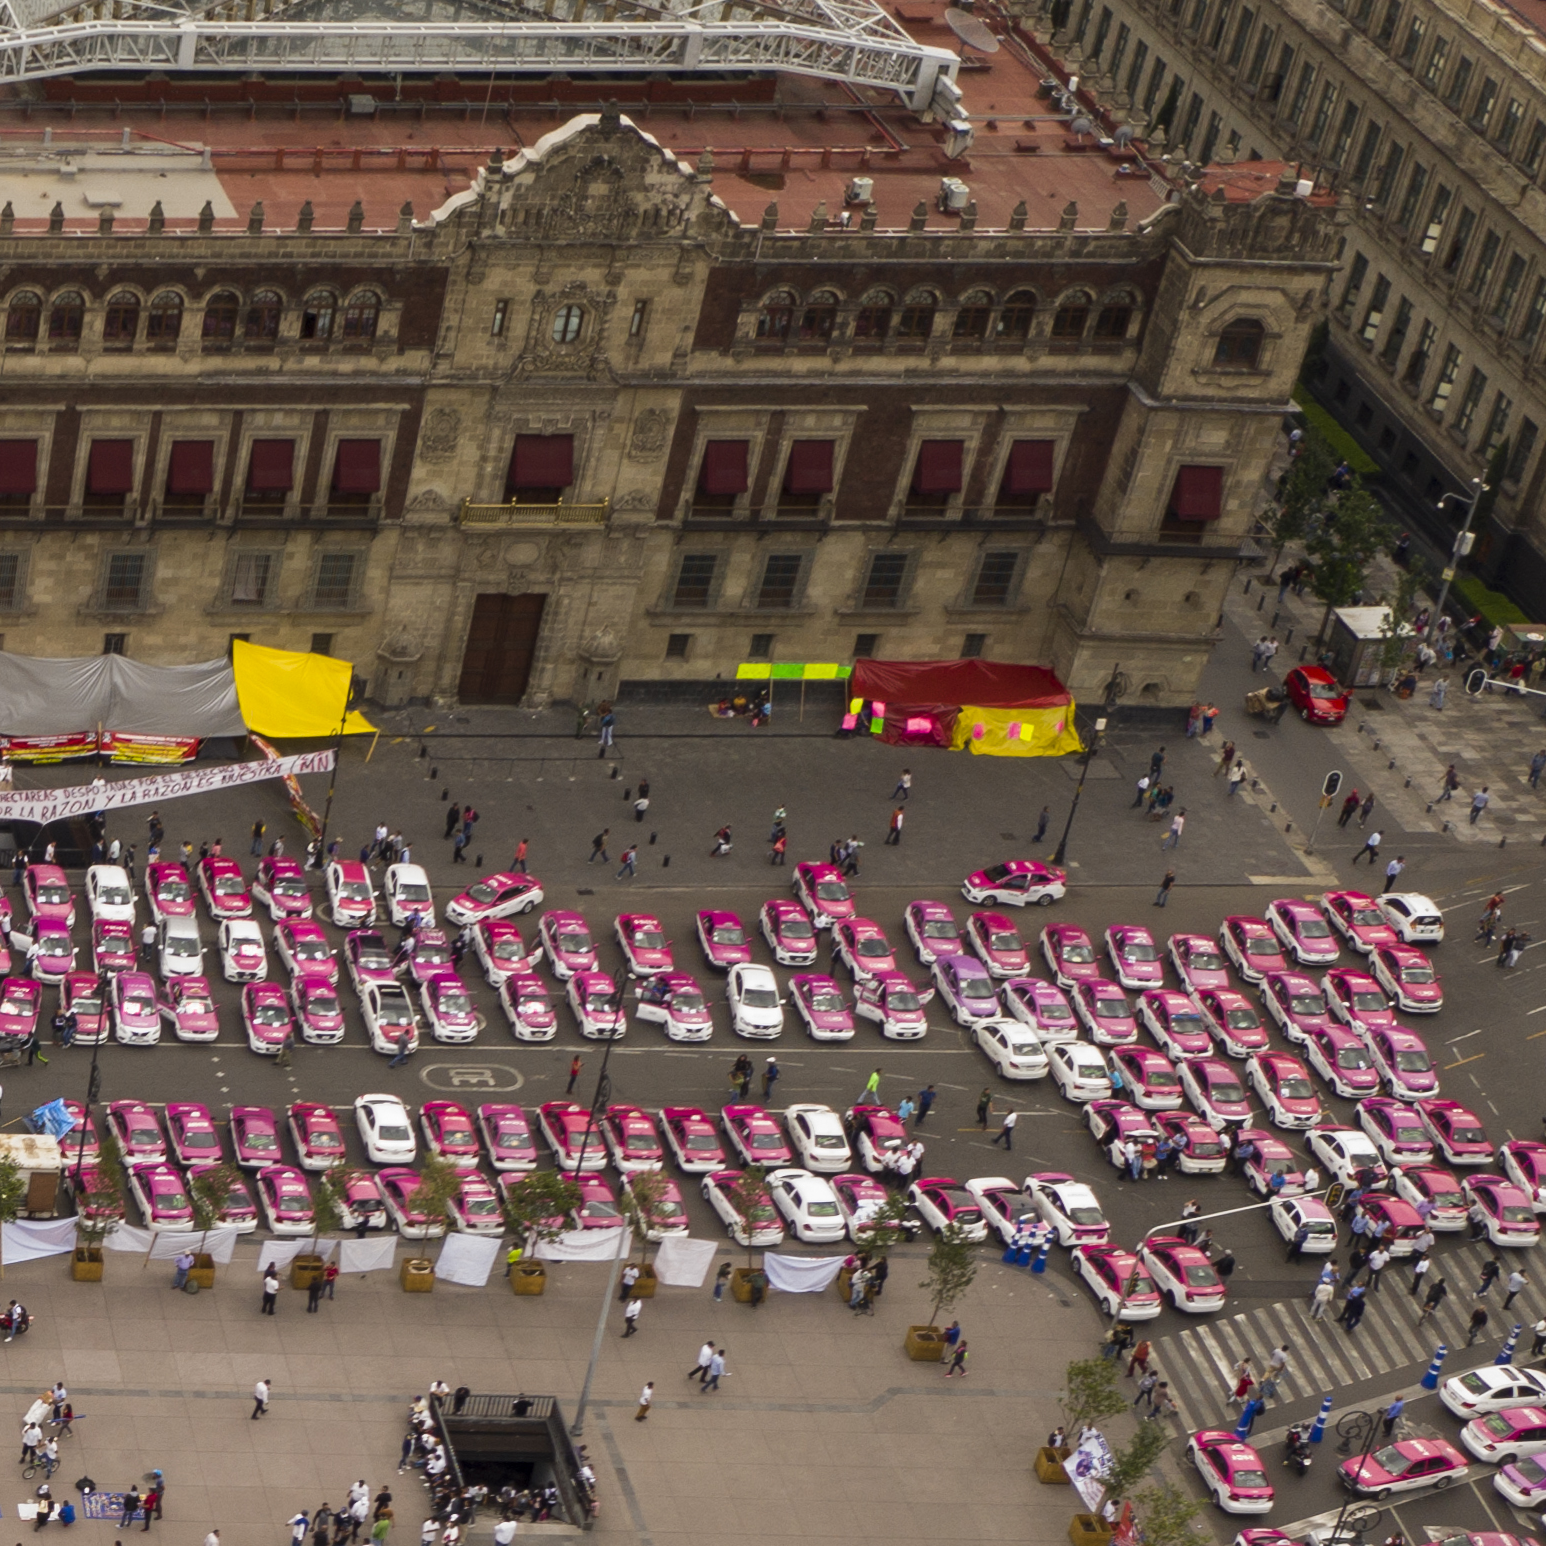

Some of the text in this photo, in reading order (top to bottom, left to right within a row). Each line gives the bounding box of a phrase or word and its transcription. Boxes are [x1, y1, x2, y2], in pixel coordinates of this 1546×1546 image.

[19, 806, 35, 819] LA
[40, 799, 96, 822] RAZON
[104, 794, 116, 808] Y
[121, 790, 137, 804] LA
[142, 778, 193, 800] RAZON
[197, 776, 212, 788] ES
[221, 763, 282, 784] NUESTRA
[63, 778, 136, 800] DESPOJADAS
[139, 777, 157, 788] POR
[162, 773, 175, 783] EL
